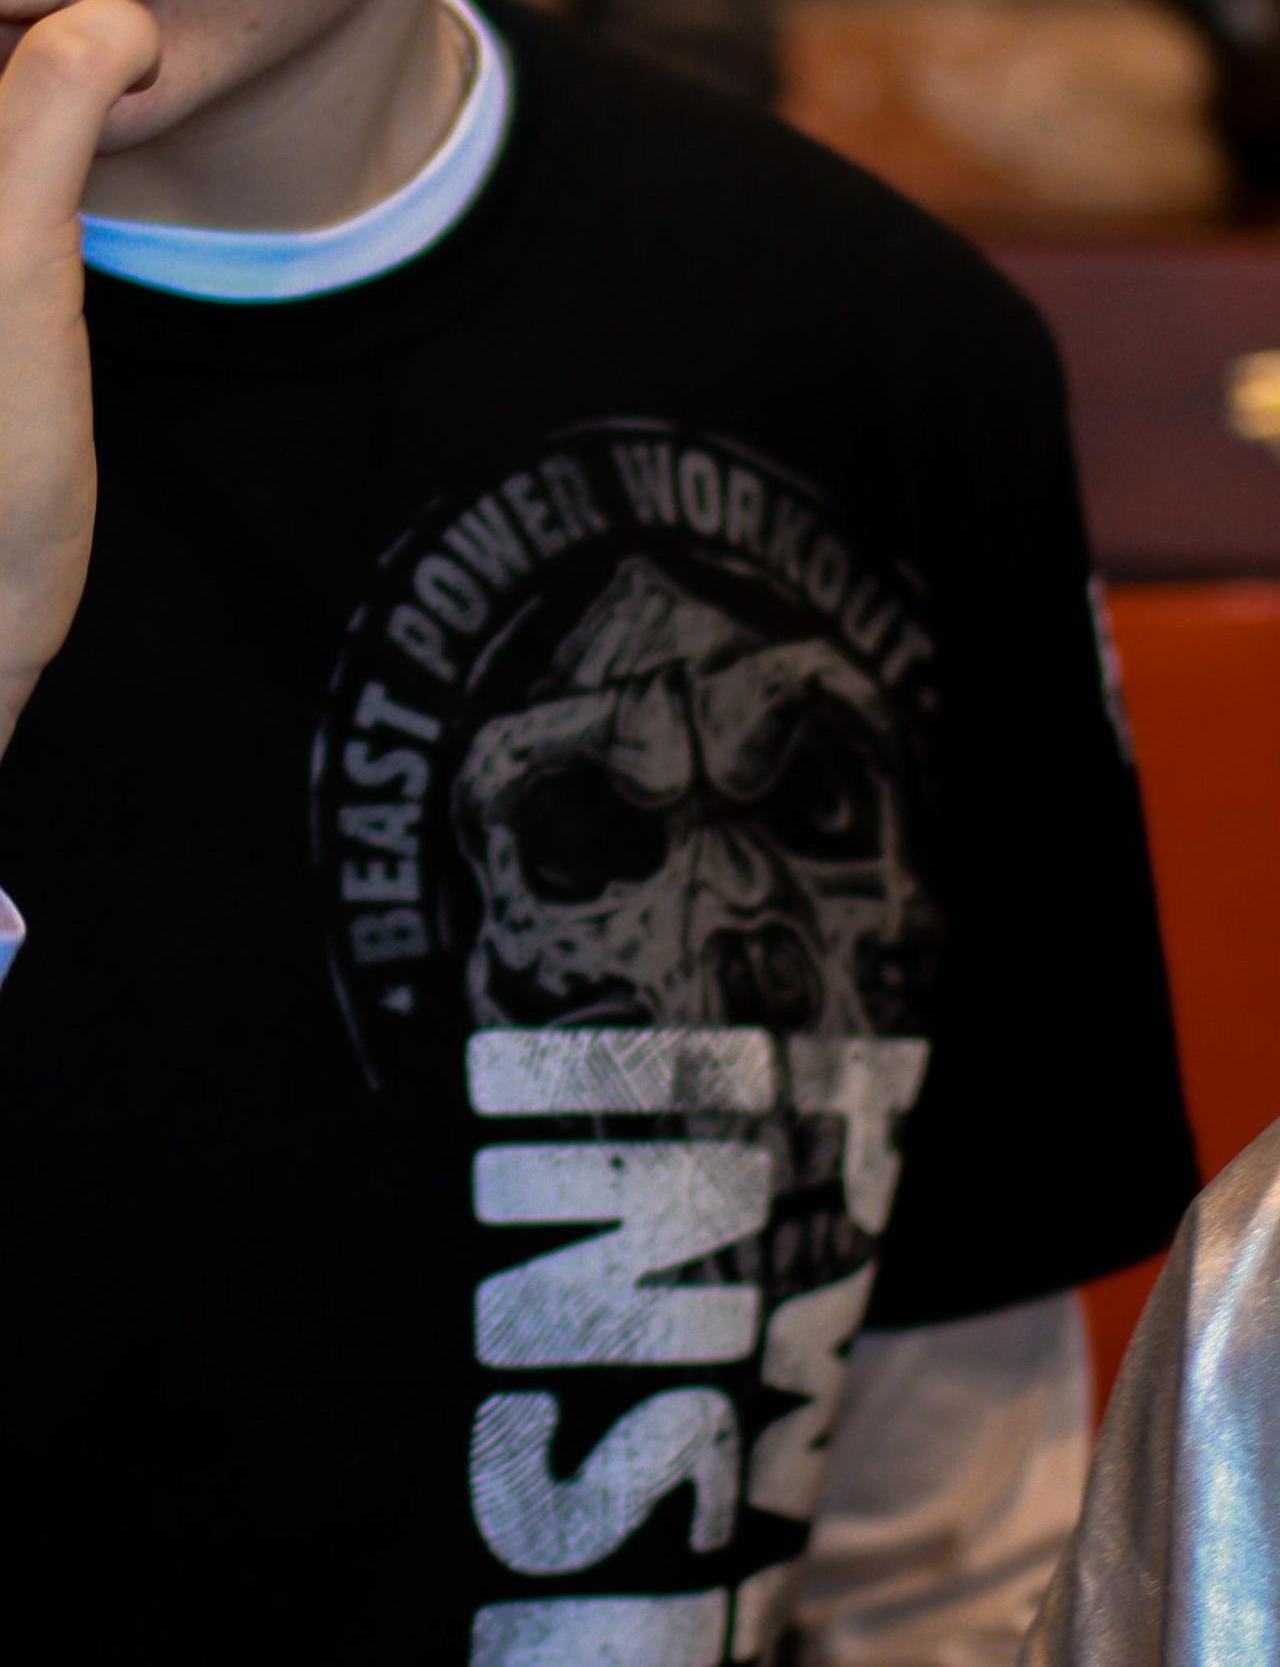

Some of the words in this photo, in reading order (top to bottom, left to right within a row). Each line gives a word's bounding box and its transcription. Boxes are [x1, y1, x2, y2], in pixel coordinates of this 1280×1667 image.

[386, 453, 610, 682] POWER
[612, 441, 939, 685] WORKOUT
[336, 679, 443, 965] BEAST
